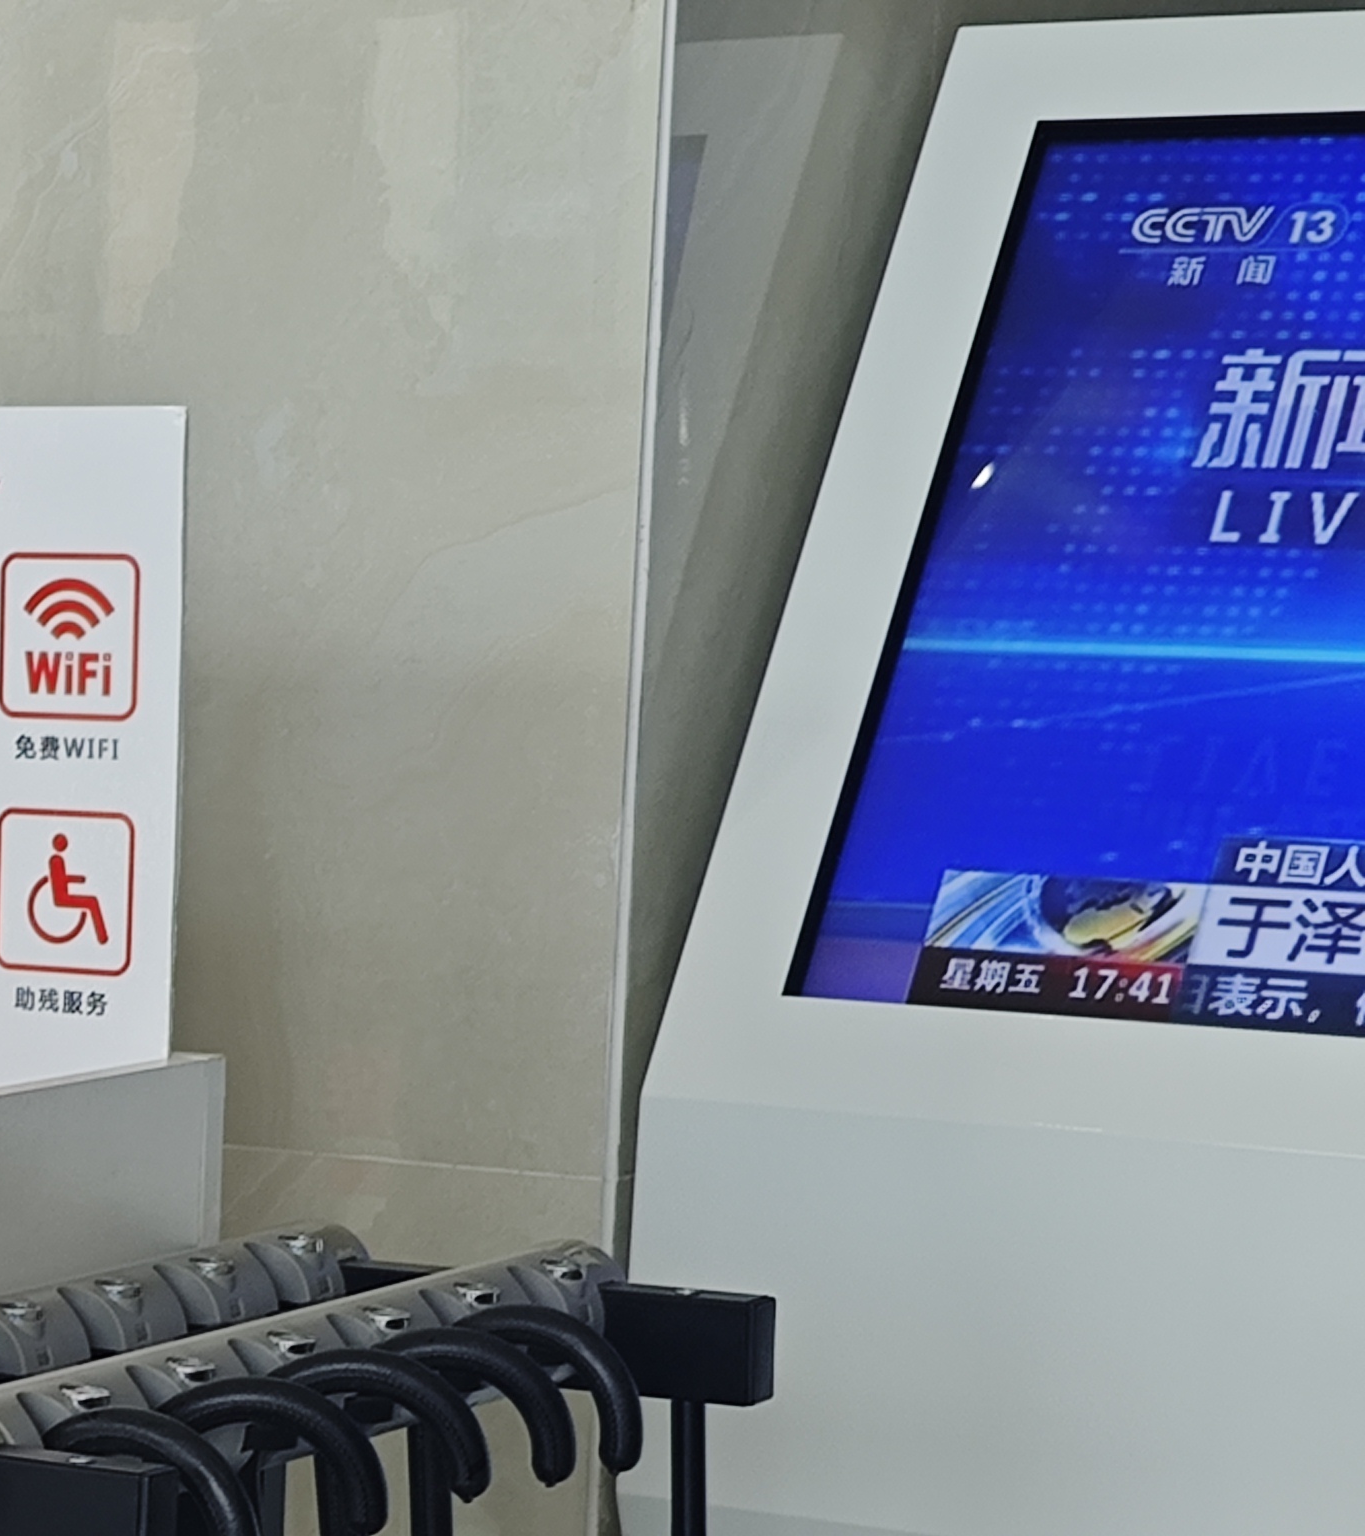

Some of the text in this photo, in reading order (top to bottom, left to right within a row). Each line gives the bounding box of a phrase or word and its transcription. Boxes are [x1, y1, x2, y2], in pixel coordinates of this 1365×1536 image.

[1131, 206, 1336, 244] CCTV 13
[1167, 255, 1277, 286] 新闻
[25, 651, 113, 697] WiFi
[14, 734, 120, 762] 免费WIFI
[1234, 840, 1365, 887] 中国人
[1217, 897, 1365, 965] 于泽
[14, 986, 109, 1018] 助残服务
[939, 957, 1174, 1005] 星期五 17:41
